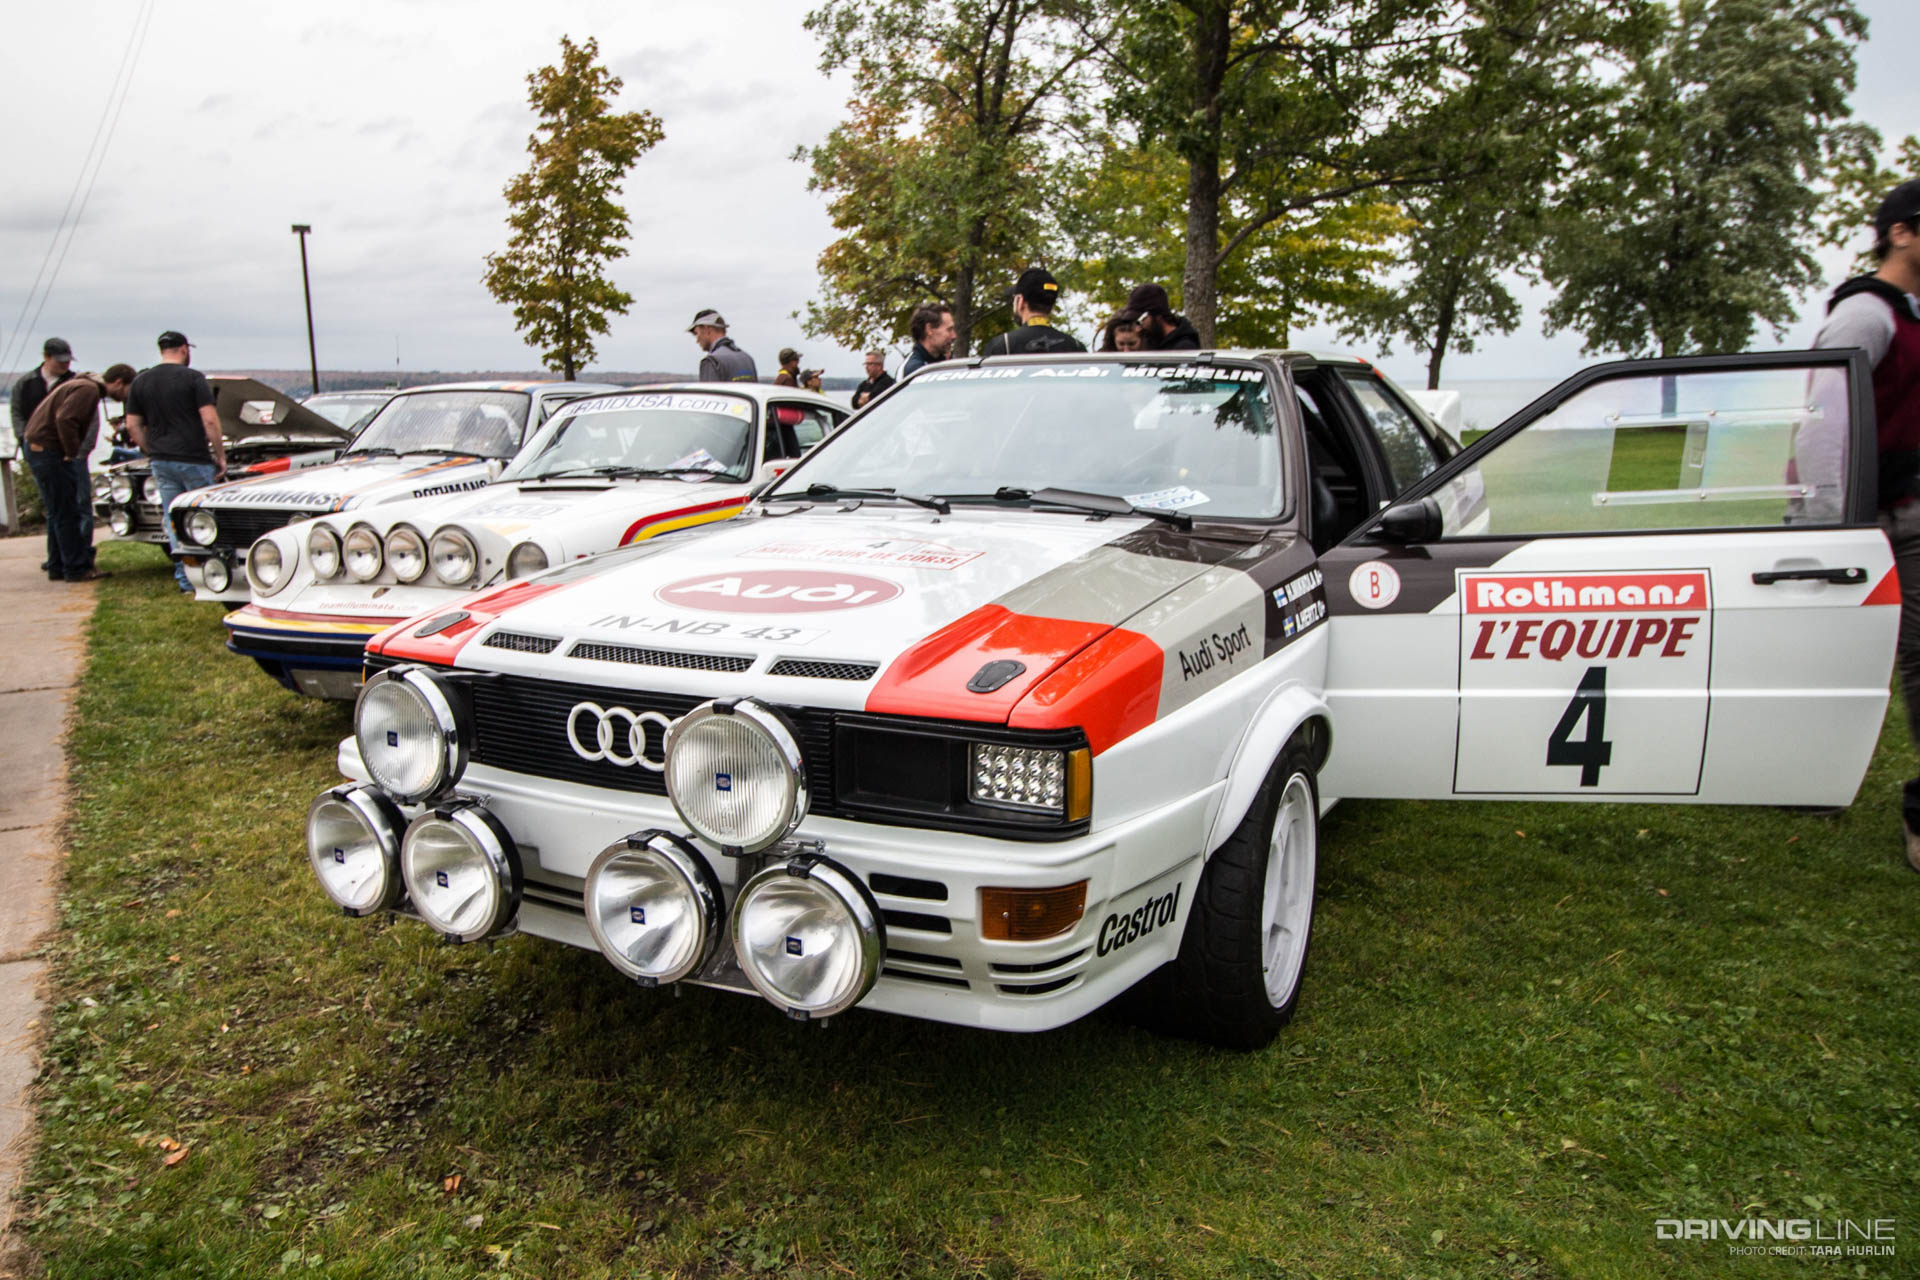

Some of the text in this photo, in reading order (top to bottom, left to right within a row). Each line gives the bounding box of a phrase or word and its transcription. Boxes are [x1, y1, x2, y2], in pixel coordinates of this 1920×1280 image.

[1029, 365, 1110, 378] Audi
[1122, 365, 1264, 383] MICHELIN
[897, 552, 961, 565] CORSE
[670, 577, 879, 604] Audi
[1370, 571, 1381, 599] B
[1477, 581, 1695, 608] Rothmans
[586, 614, 803, 642] IN-NB 43
[1470, 617, 1700, 662] L'EQUIPE
[1178, 622, 1251, 681] Audi Sport
[1546, 666, 1613, 787] 4
[1097, 881, 1182, 958] Castrol
